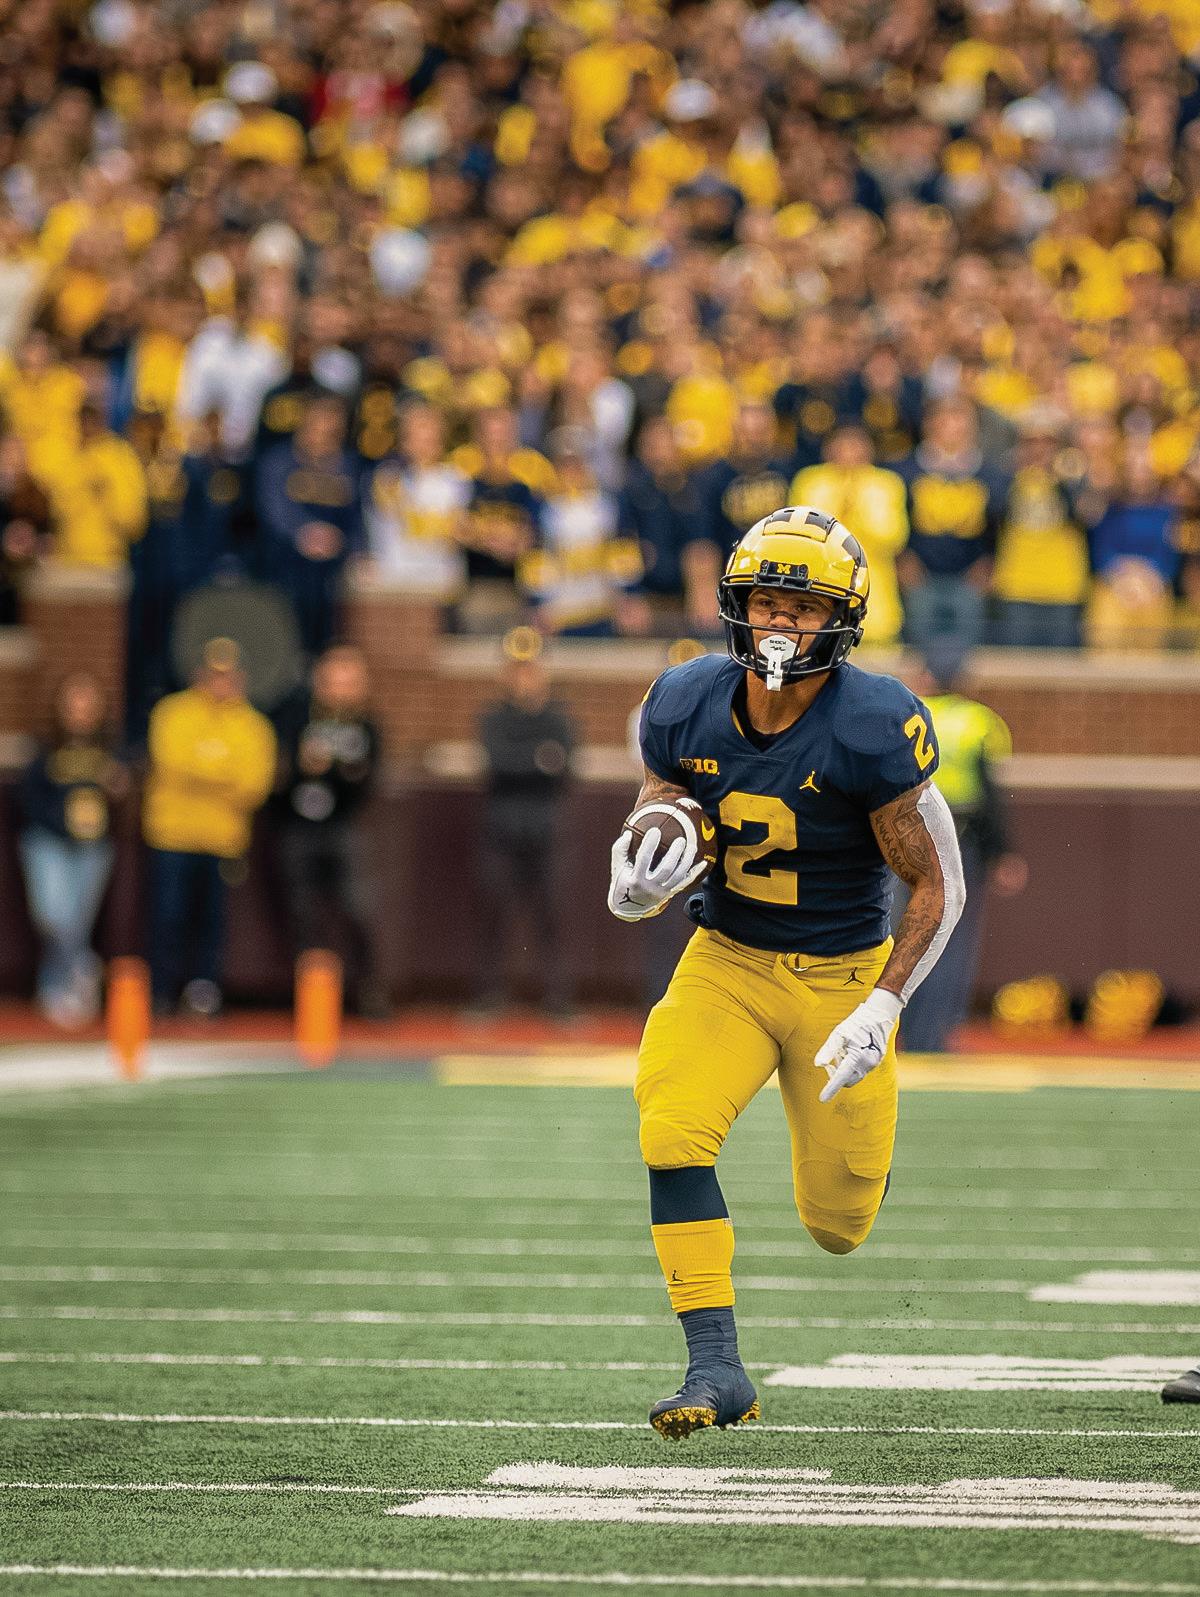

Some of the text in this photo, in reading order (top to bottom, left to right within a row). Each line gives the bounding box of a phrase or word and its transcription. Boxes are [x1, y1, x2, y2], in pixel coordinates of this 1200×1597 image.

[776, 563, 792, 575] M
[904, 714, 936, 771] 2
[719, 791, 798, 906] 2
